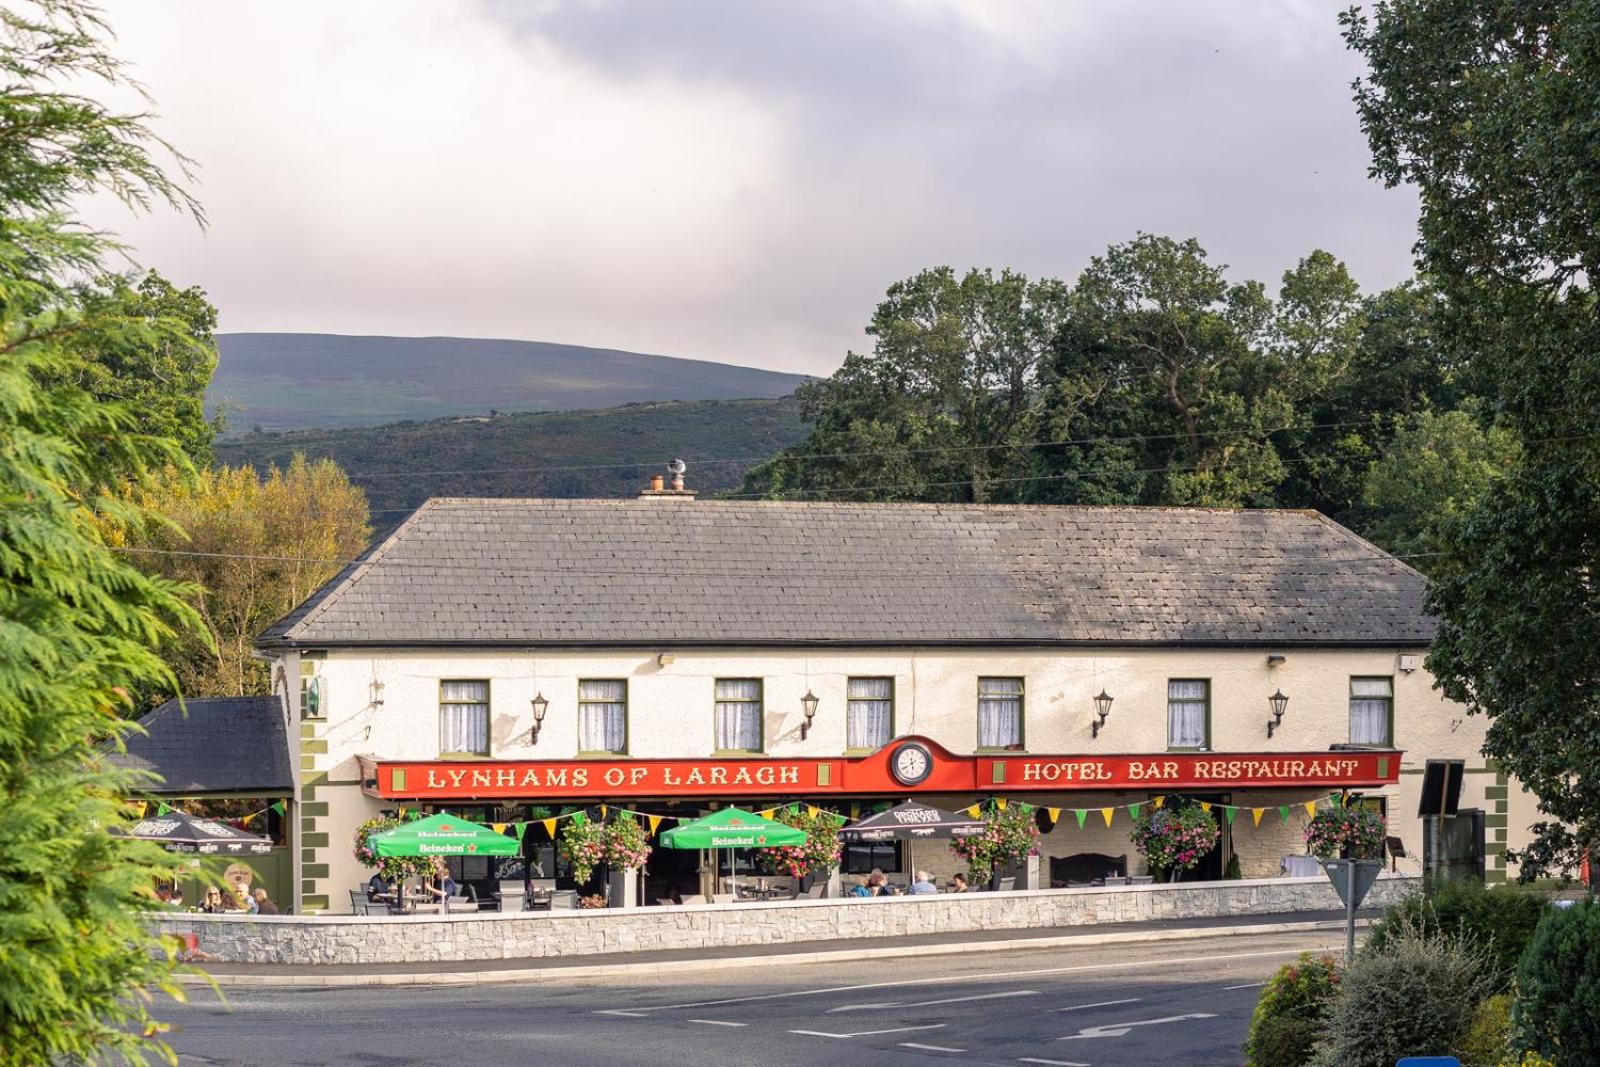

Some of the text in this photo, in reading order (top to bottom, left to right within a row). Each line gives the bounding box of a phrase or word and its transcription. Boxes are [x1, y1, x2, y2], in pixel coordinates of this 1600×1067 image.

[427, 766, 800, 789] LYNHAMS OF LARAGH
[1022, 760, 1359, 781] HOTEL BAR RESTAURANT
[419, 843, 465, 853] Heineken
[712, 836, 754, 846] Heineken
